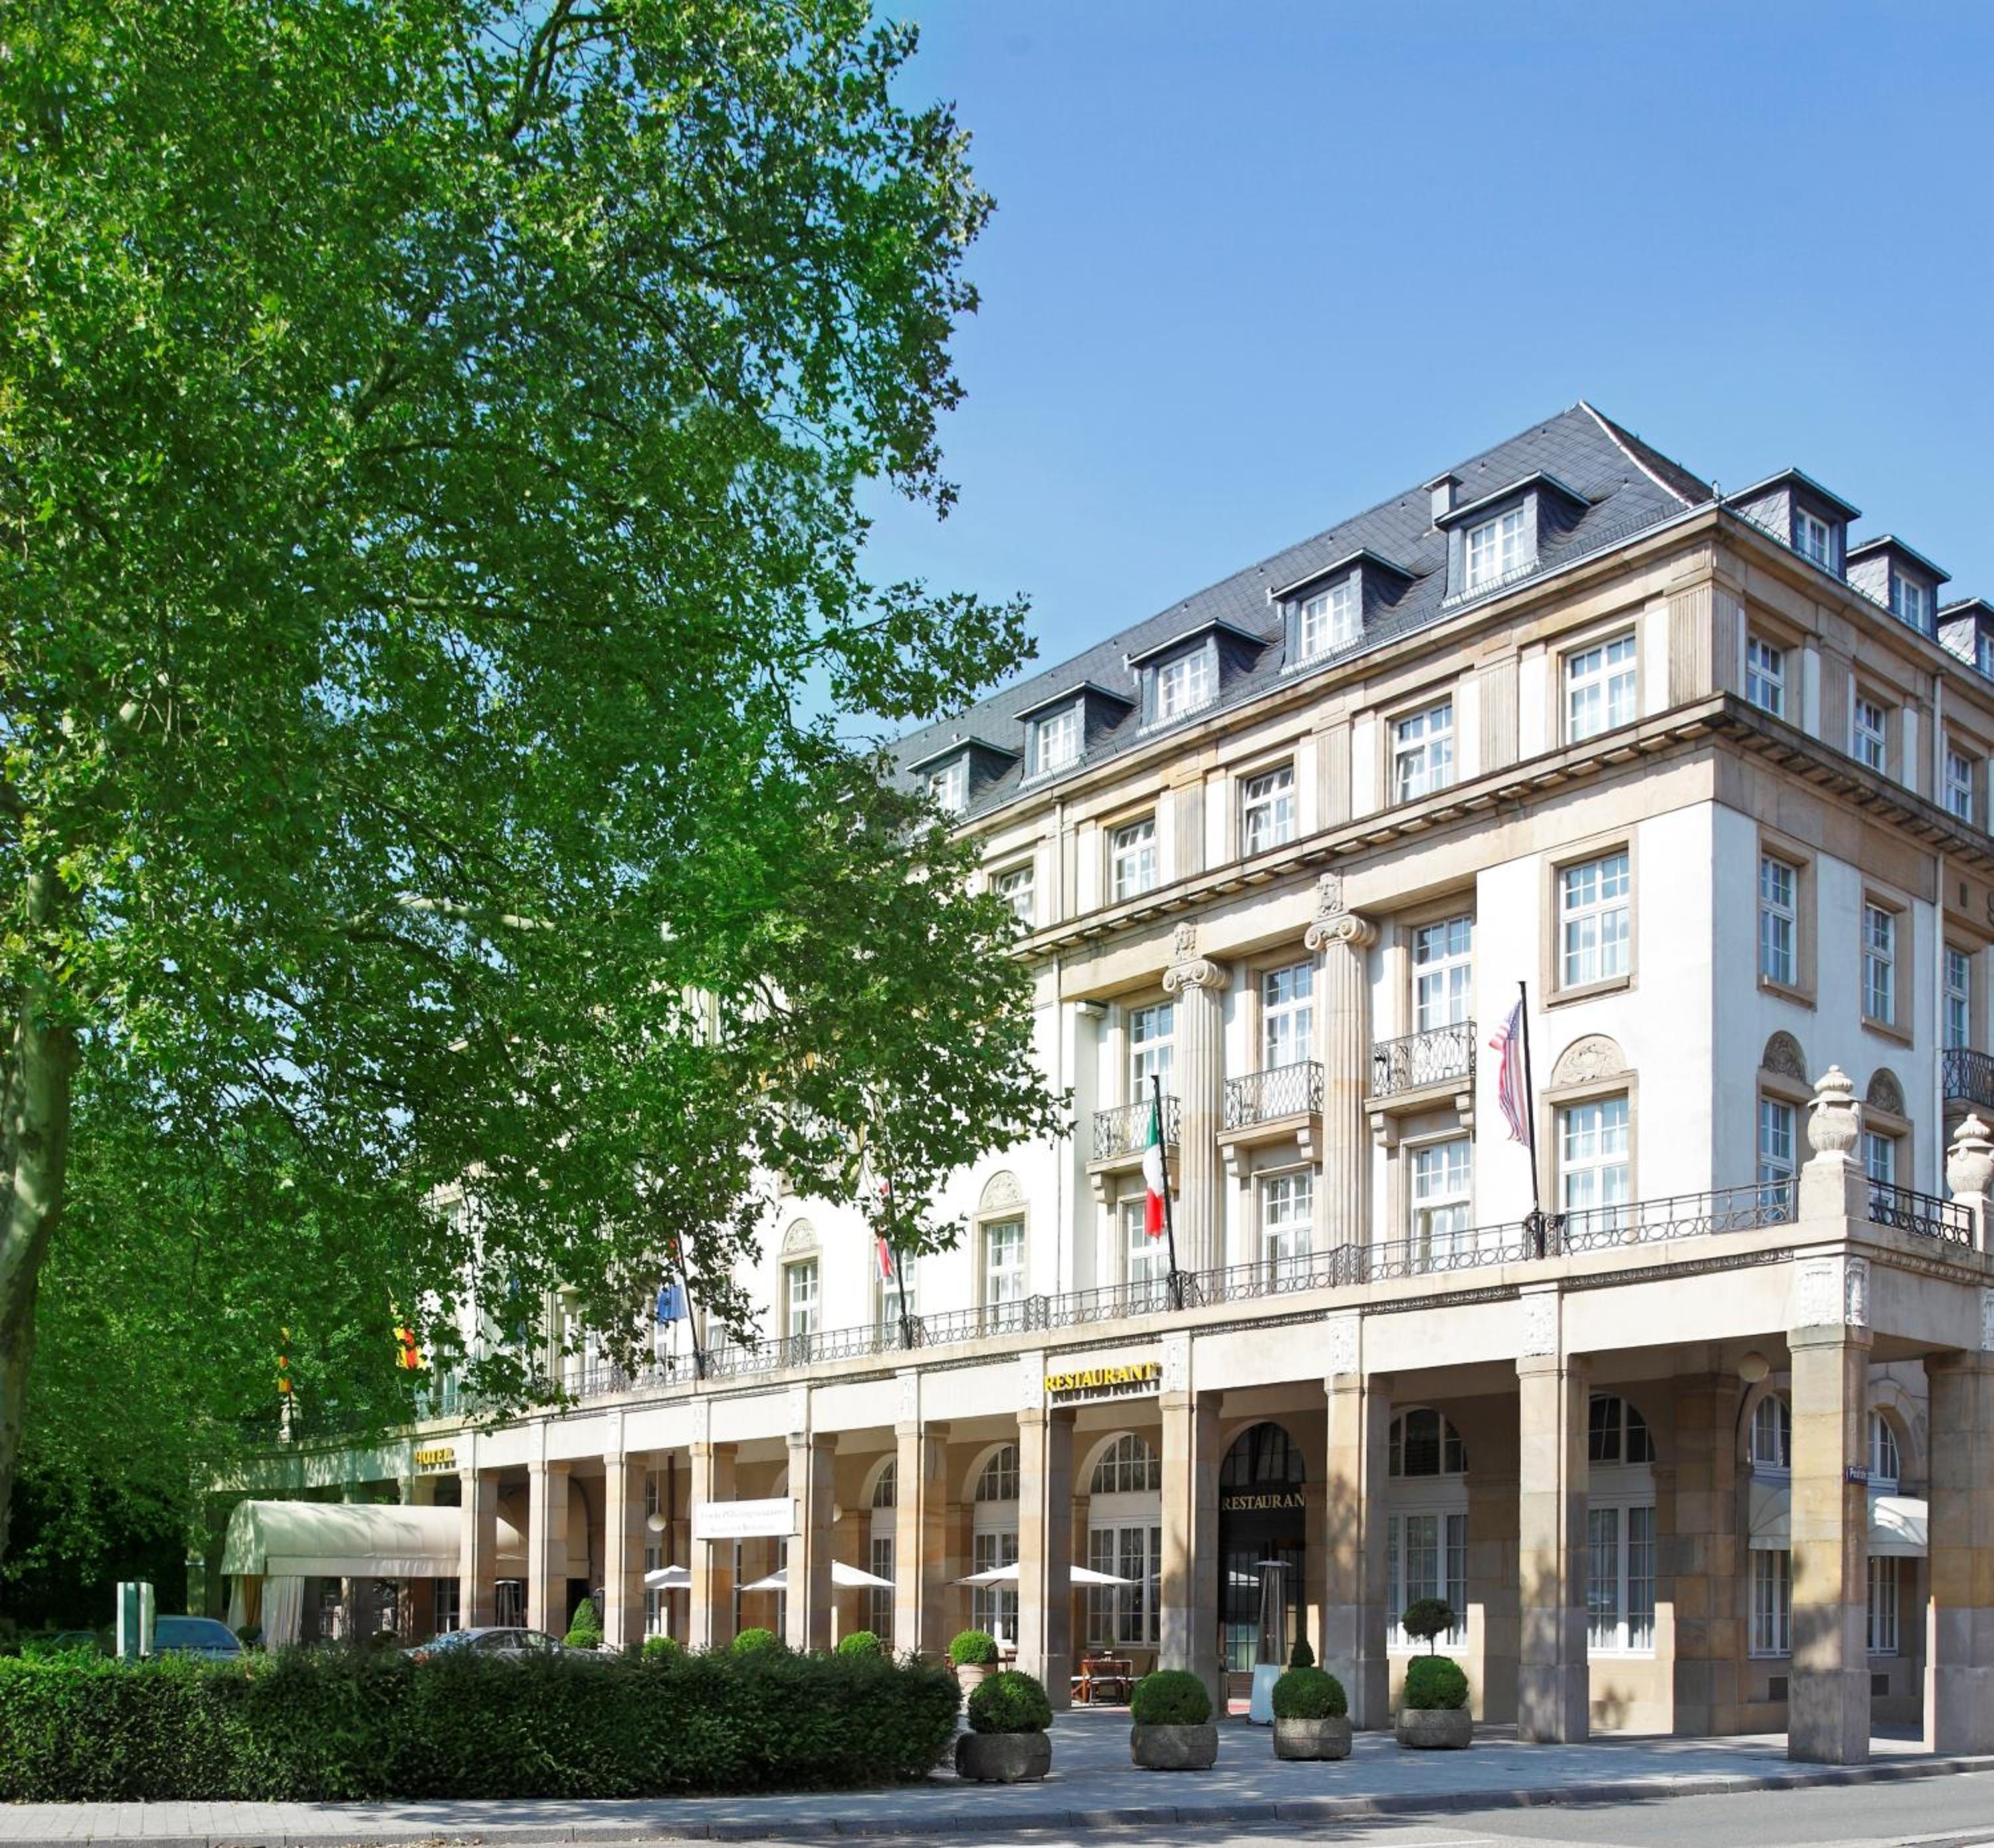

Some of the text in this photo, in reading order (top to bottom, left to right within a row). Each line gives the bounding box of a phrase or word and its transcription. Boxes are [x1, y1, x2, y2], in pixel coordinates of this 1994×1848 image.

[1044, 1361, 1157, 1392] RESTAURANT
[414, 1447, 453, 1465] HOTEL
[1222, 1493, 1305, 1510] RESTAURAN
